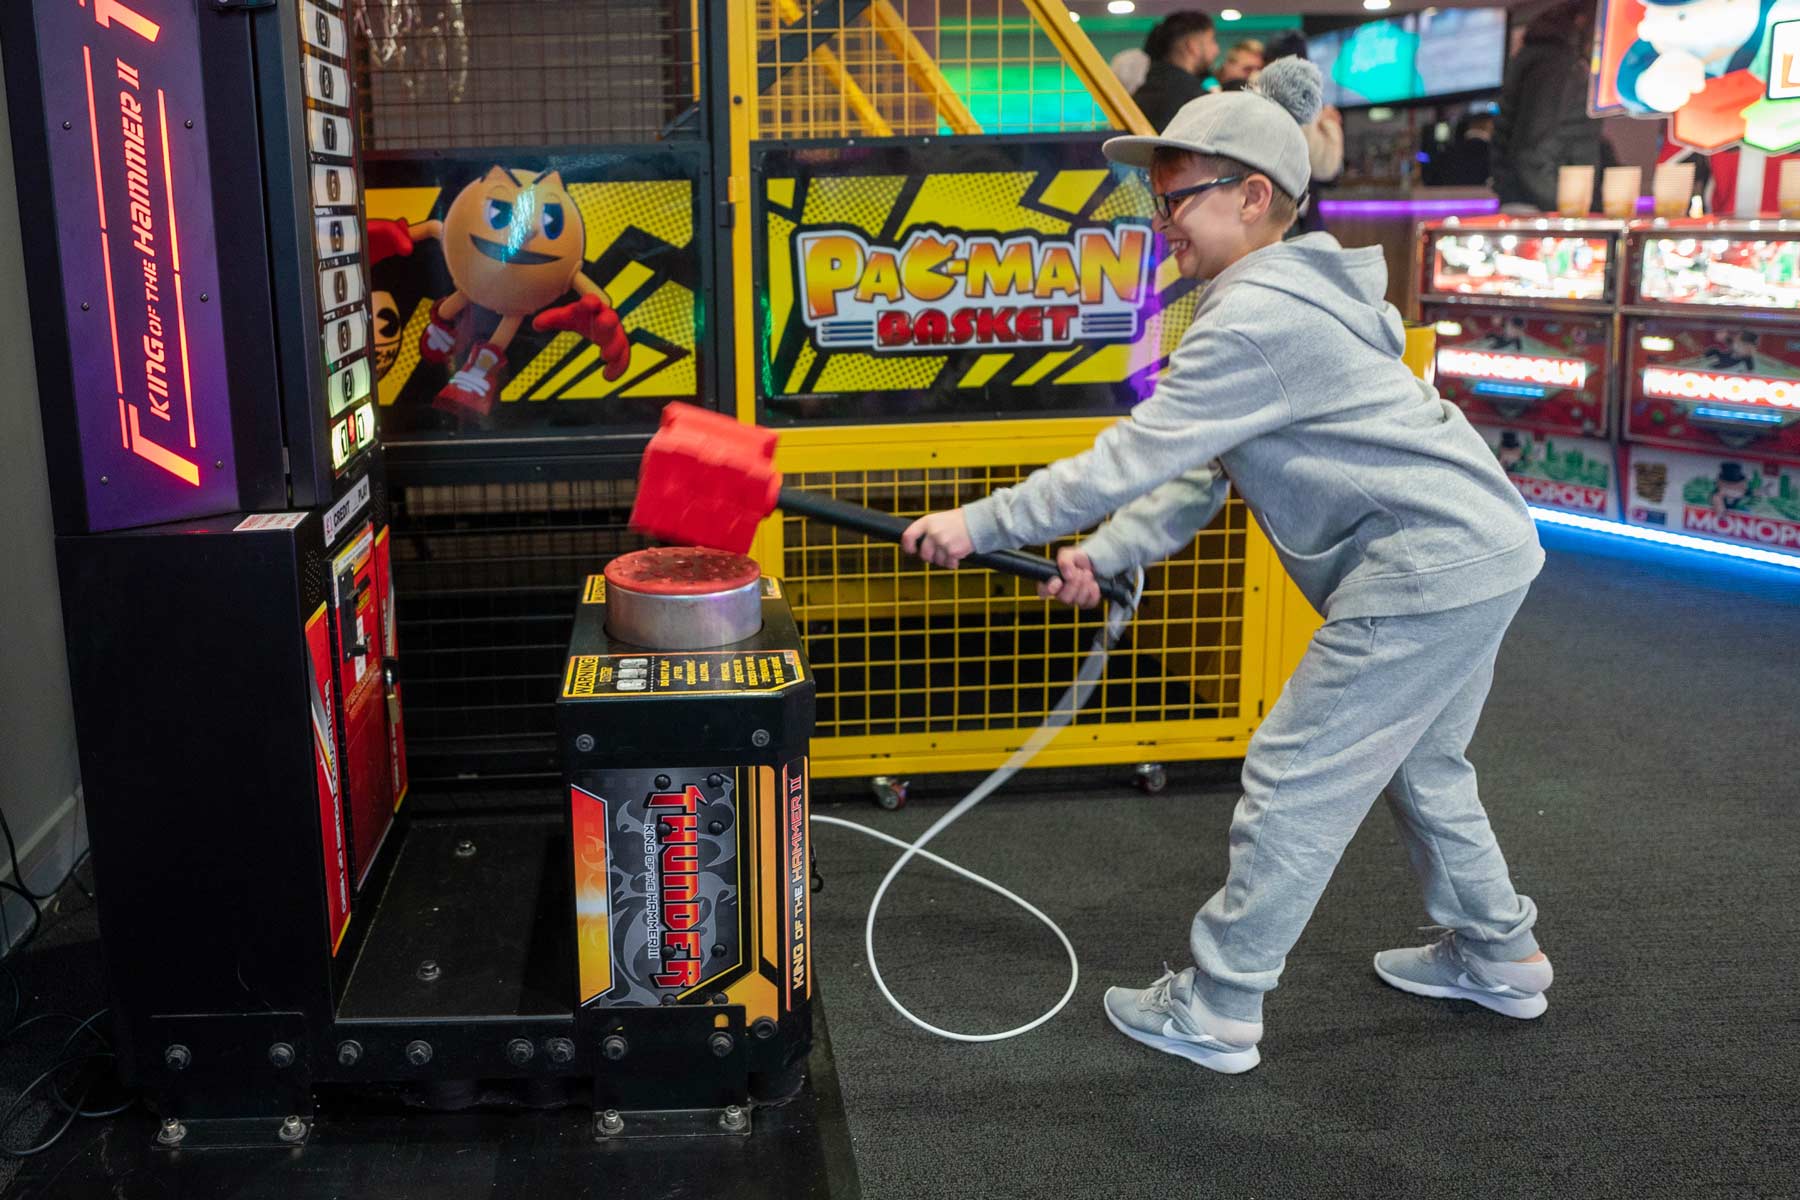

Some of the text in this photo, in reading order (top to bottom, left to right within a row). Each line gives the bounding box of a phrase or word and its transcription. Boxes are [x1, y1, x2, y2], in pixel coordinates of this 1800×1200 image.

[116, 57, 140, 90] II
[143, 258, 160, 302] THE
[802, 230, 1147, 321] PAC-MAN
[147, 304, 163, 337] OF
[876, 304, 1079, 347] BASKET
[143, 334, 171, 421] KING
[1650, 368, 1800, 408] MONOPO
[1686, 508, 1800, 548] MONOP
[644, 824, 656, 854] KING
[645, 855, 655, 868] OF
[646, 869, 656, 891] THE
[642, 784, 708, 987] THUNDER
[790, 775, 804, 990] KING OF THE HAMMER II
[647, 892, 659, 946] HAMMER
